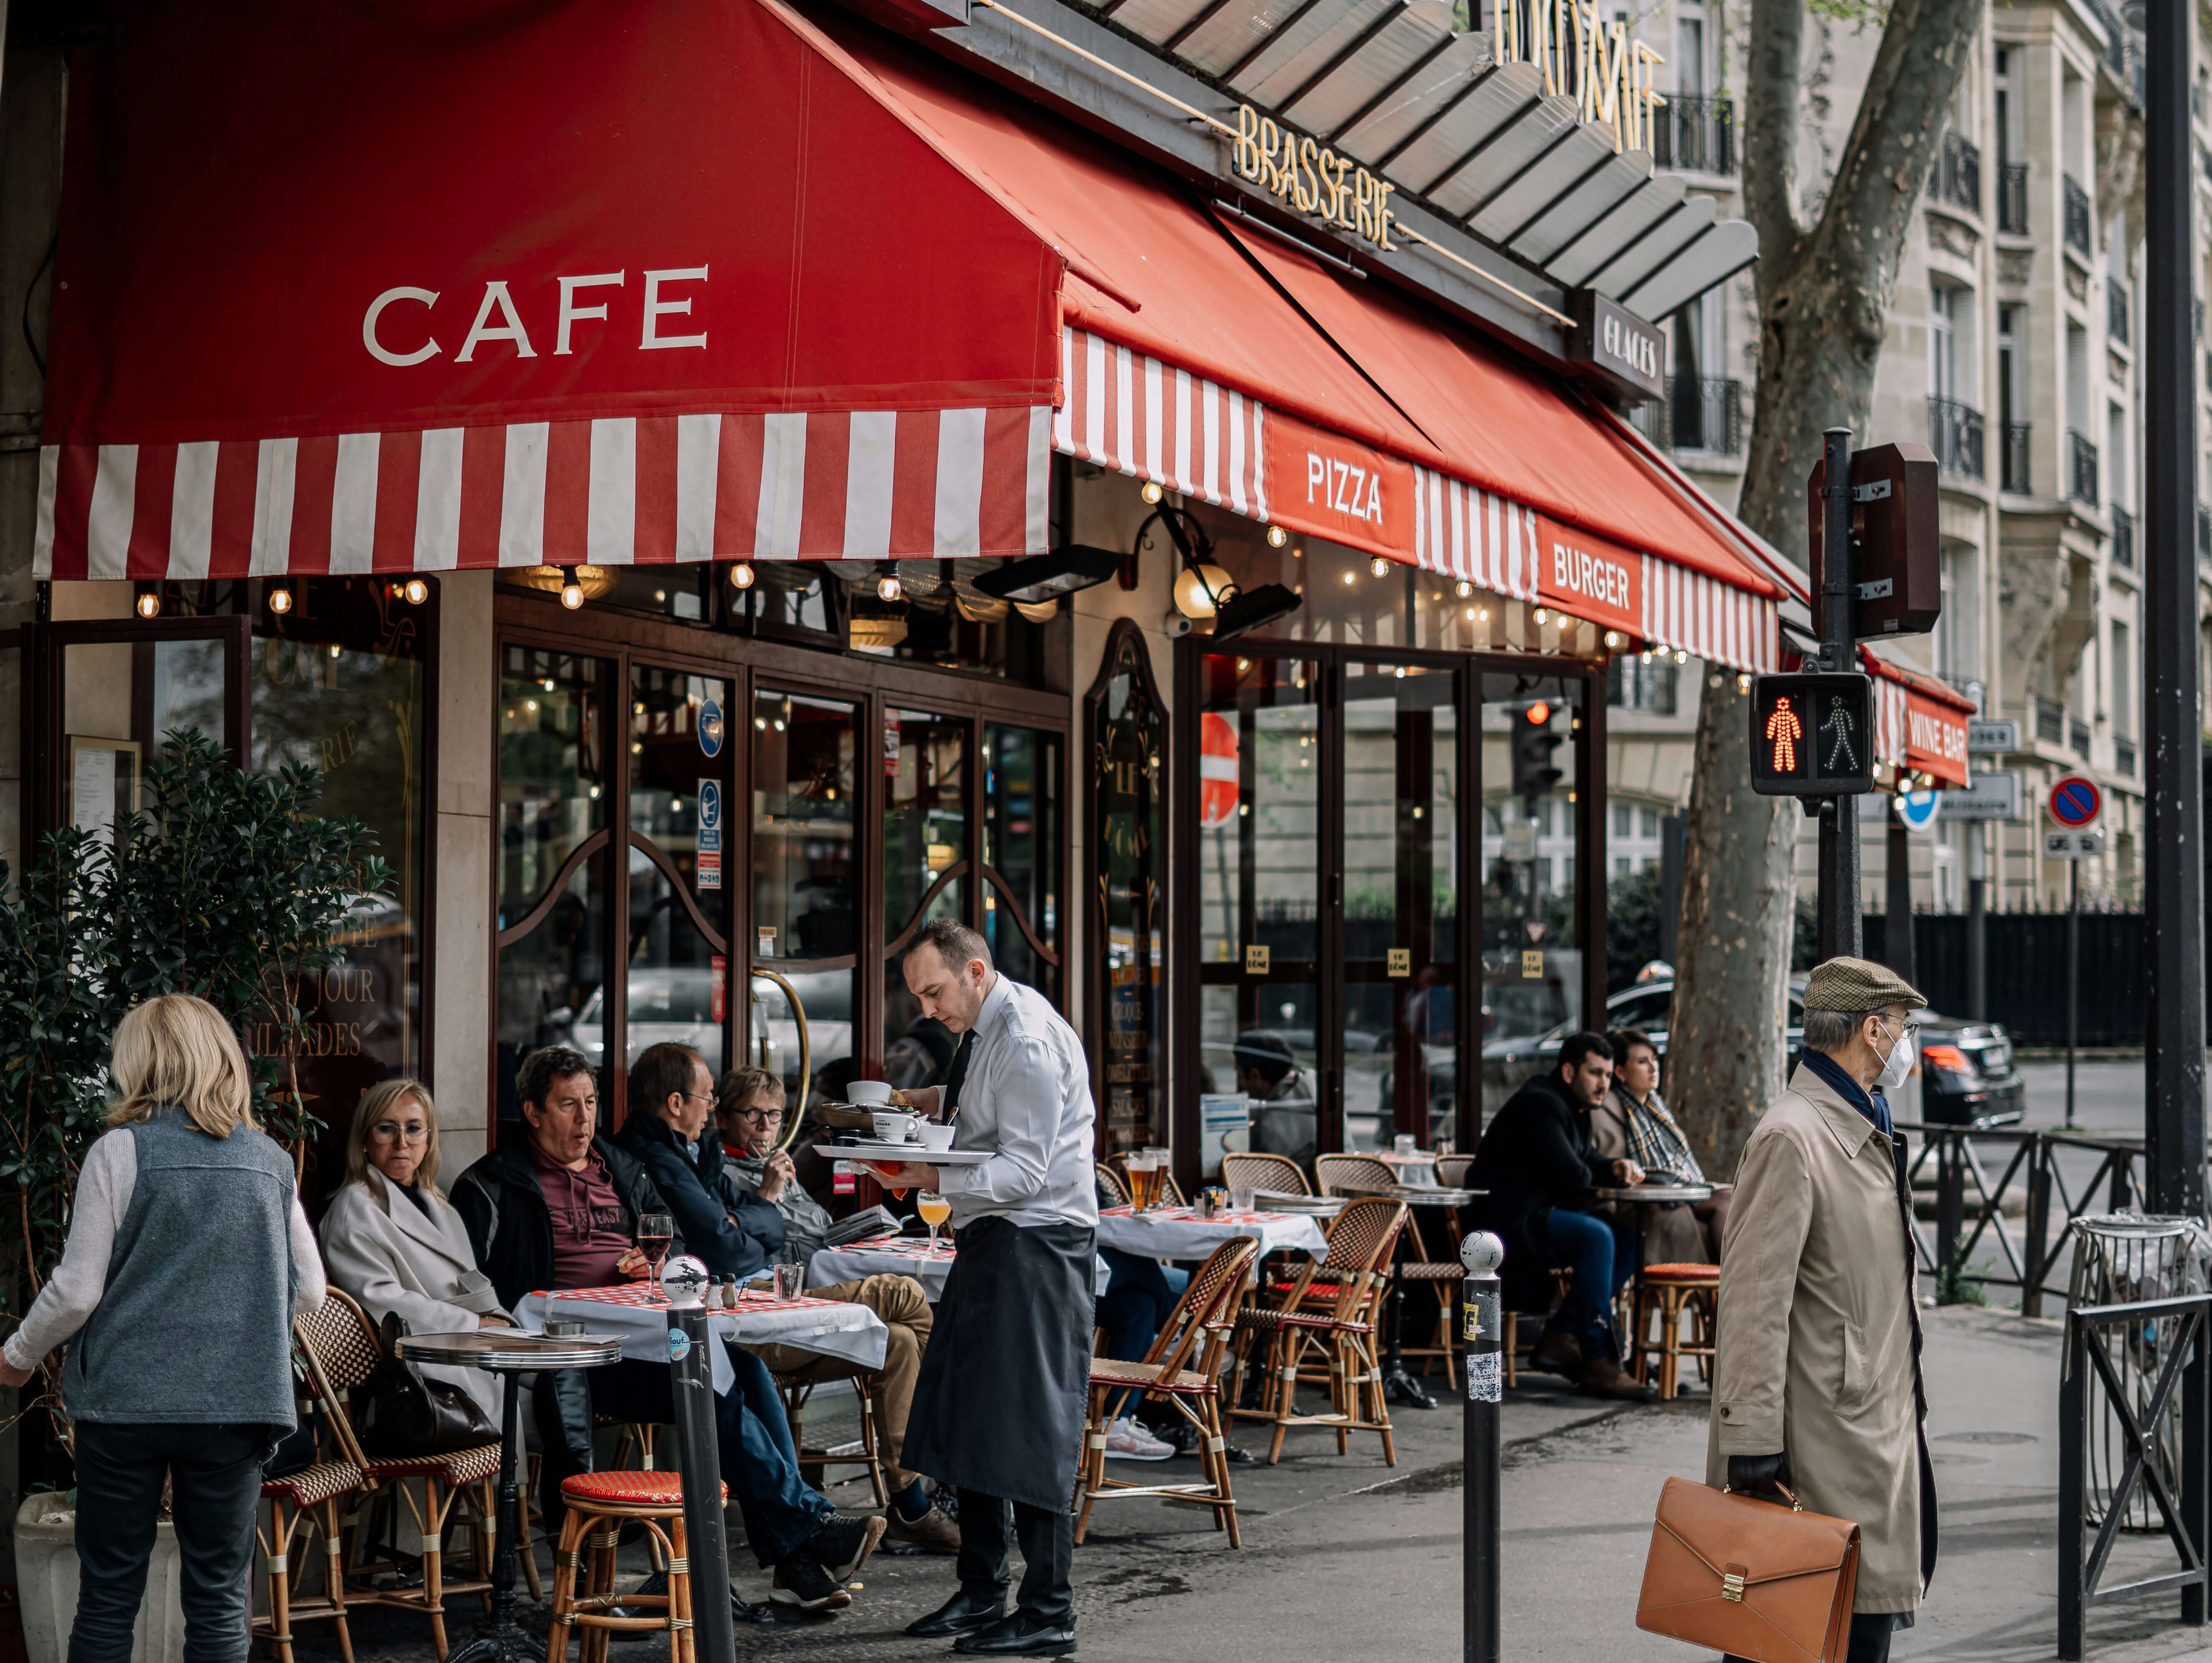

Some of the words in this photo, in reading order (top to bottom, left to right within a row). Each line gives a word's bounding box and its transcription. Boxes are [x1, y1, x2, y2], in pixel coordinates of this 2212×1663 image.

[1239, 104, 1398, 252] BRASSERIE
[363, 264, 708, 367] CAFE
[1603, 314, 1656, 379] GLACES
[1307, 452, 1383, 527] PIZZA
[1553, 542, 1630, 611] BURGER
[1908, 709, 1943, 756] WINE
[1942, 722, 1966, 764] BAR
[315, 968, 375, 1011] JOUR
[596, 1208, 620, 1224] EASY
